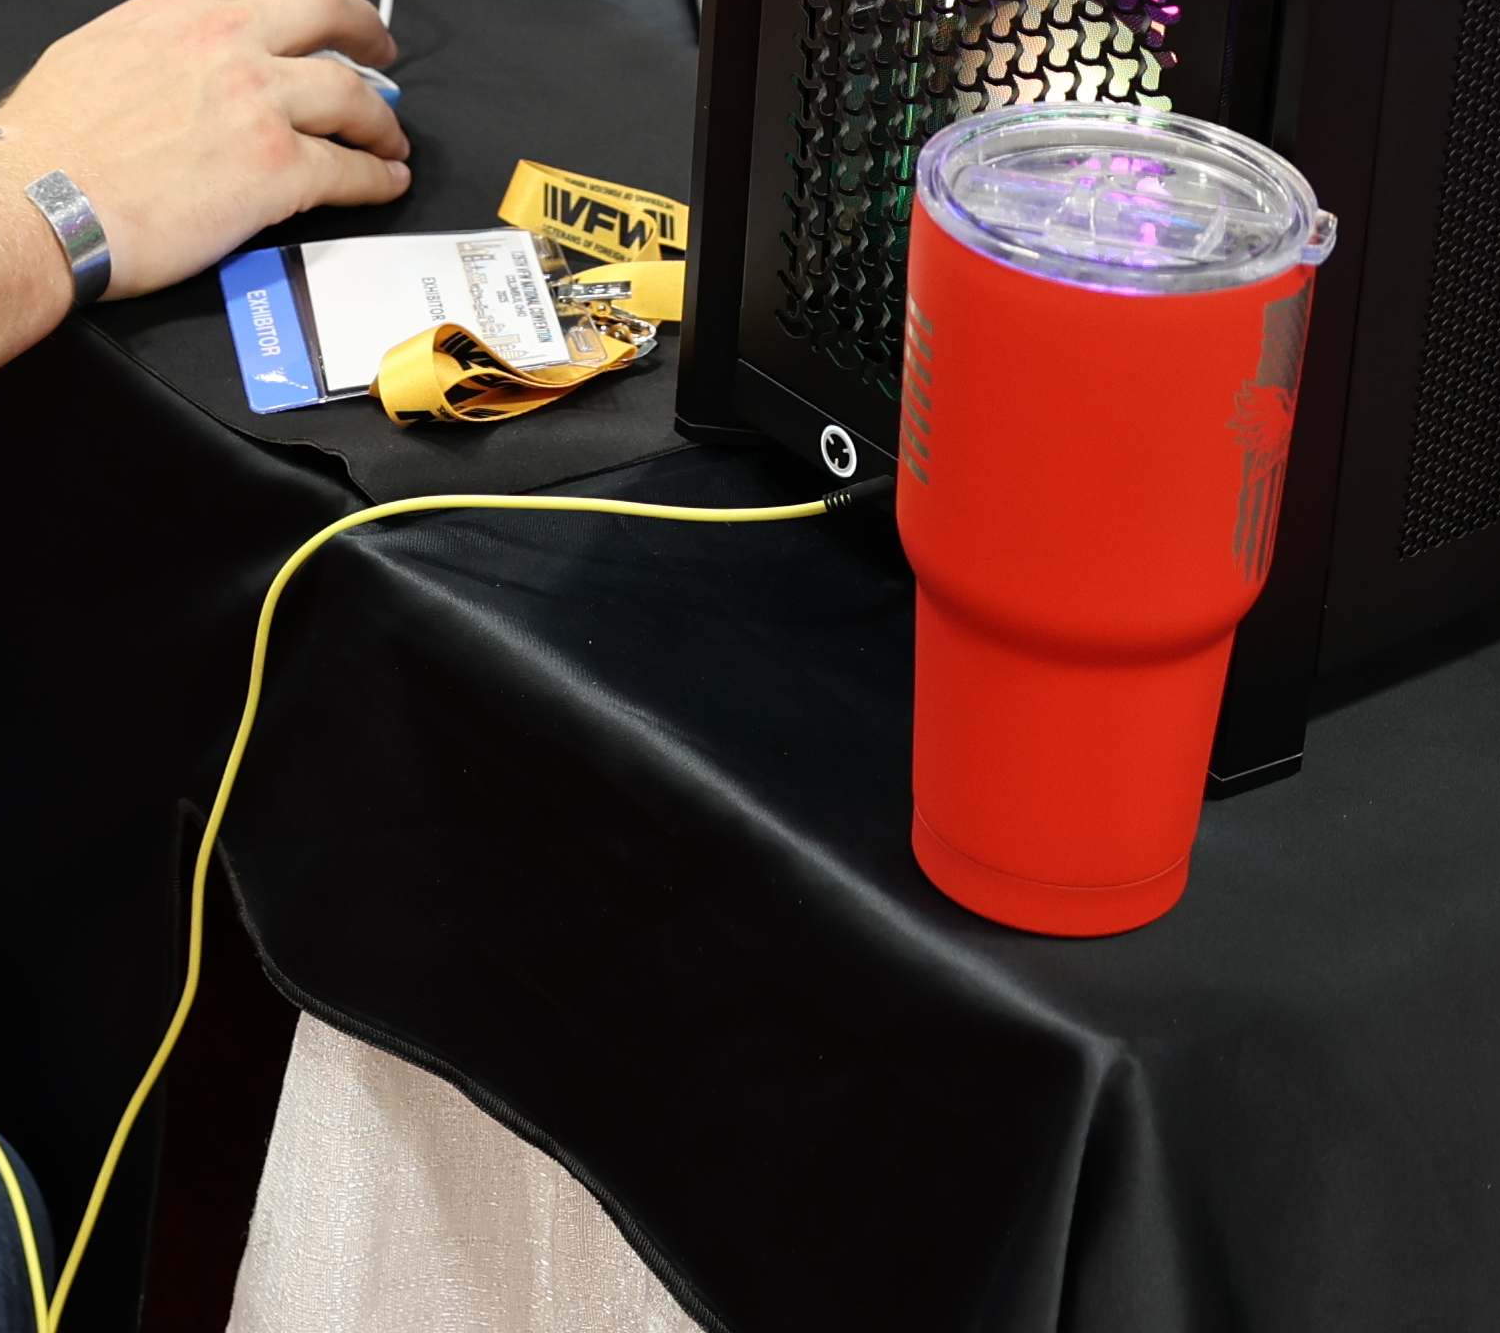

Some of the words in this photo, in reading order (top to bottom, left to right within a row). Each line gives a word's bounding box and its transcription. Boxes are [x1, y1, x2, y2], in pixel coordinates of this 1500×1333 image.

[559, 188, 651, 251] VFW
[246, 289, 281, 357] EXHIBITOR
[421, 276, 446, 321] EXHIBITOR
